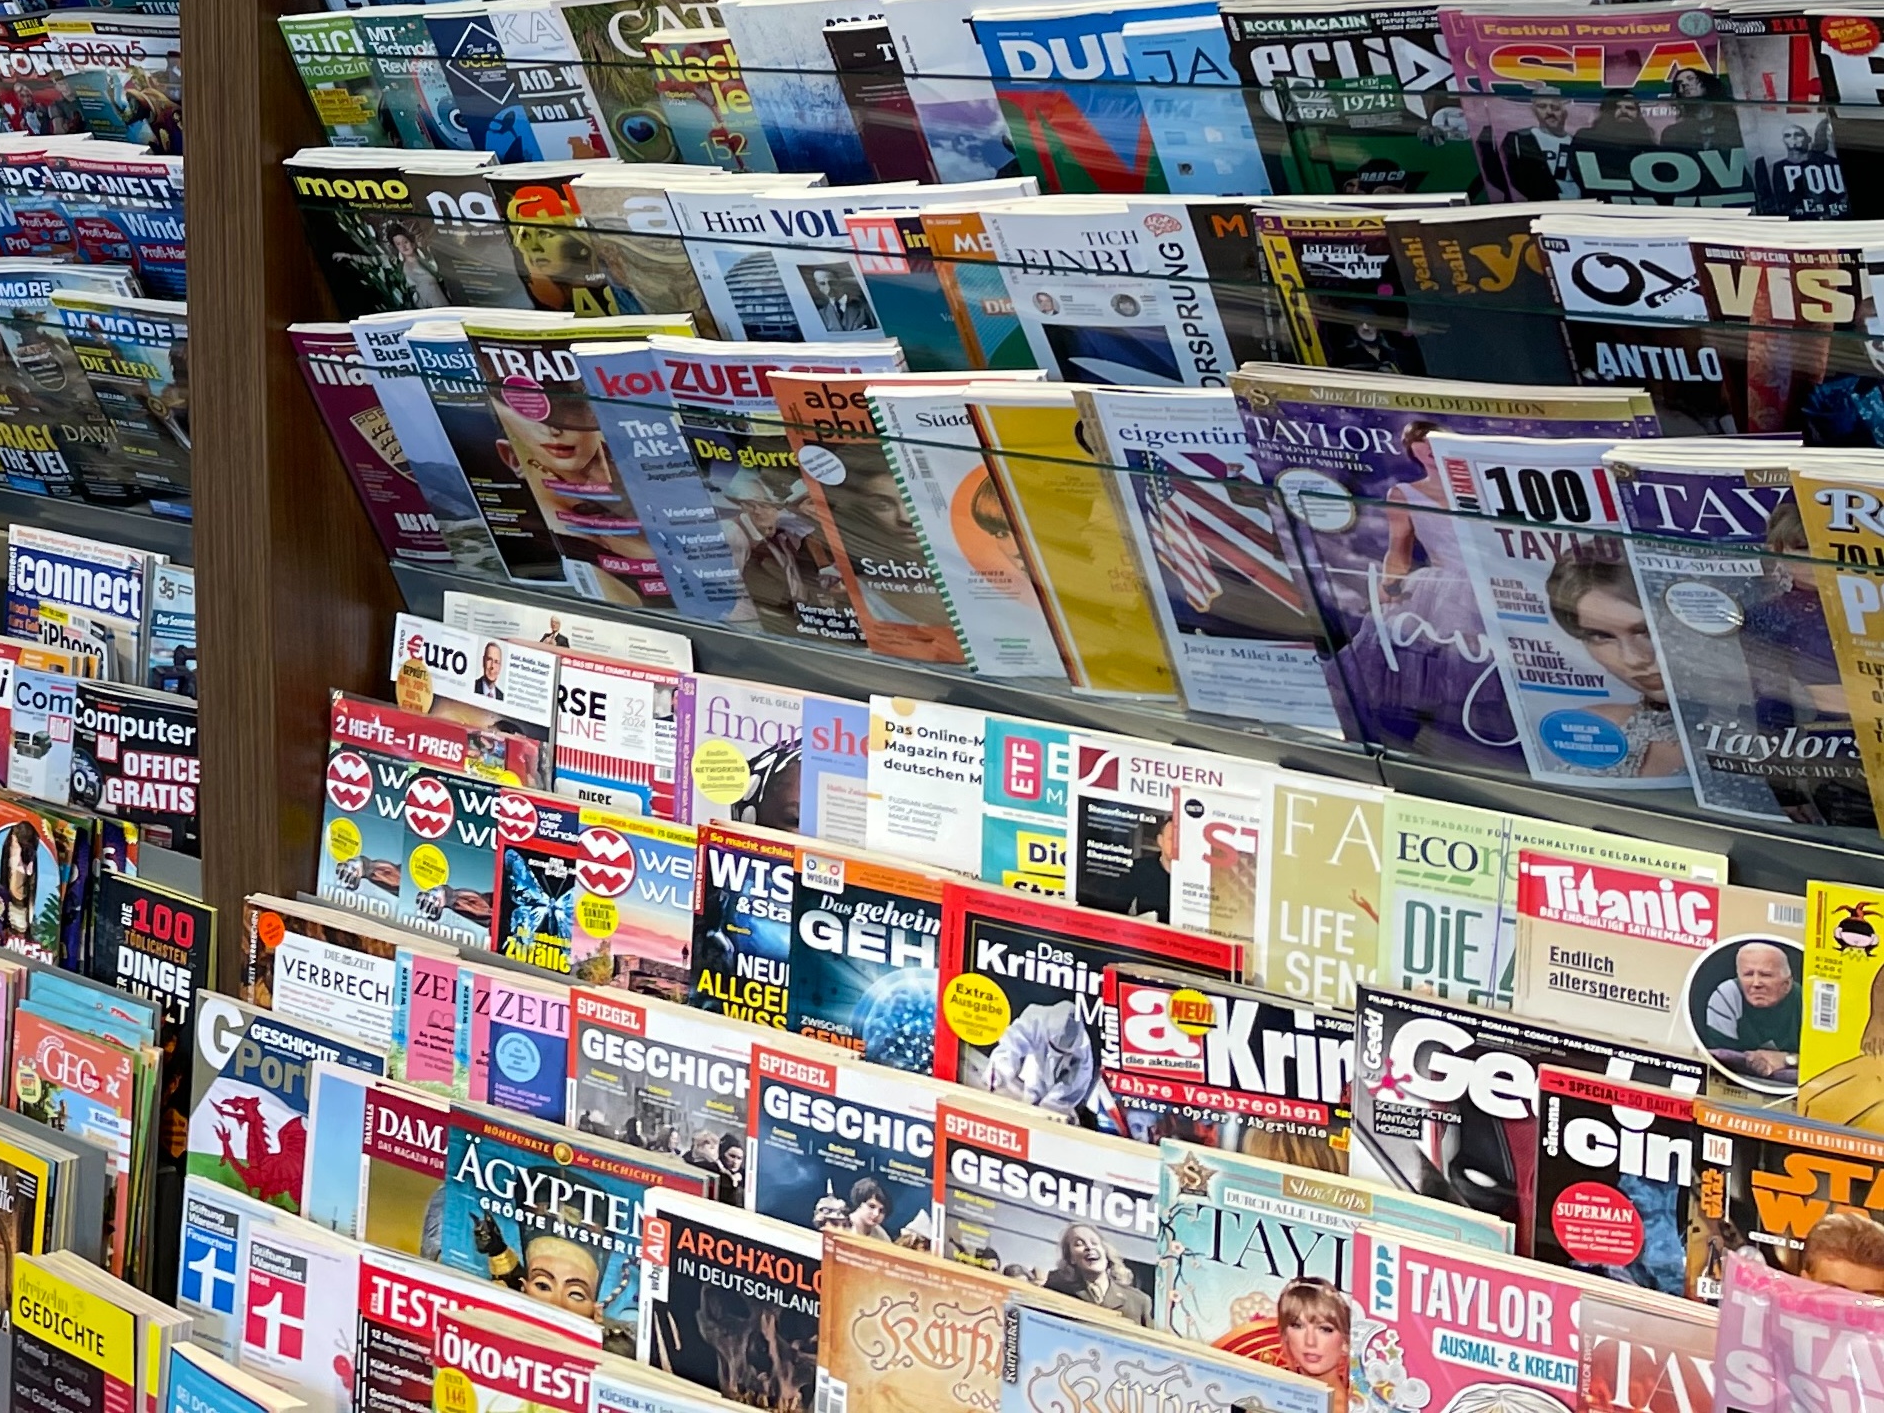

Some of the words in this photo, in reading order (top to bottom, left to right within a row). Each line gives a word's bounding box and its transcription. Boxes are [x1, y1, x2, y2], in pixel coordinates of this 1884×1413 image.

[1483, 22, 1562, 36] Festival
[1569, 19, 1671, 36] Preview
[299, 174, 409, 201] mono
[1395, 395, 1546, 417] GOLDEDITION
[695, 438, 731, 462] Die
[1245, 416, 1401, 457] TAYLOR
[1484, 467, 1592, 523] 100
[1636, 555, 1762, 575] STYLE-SPECIAL
[16, 552, 142, 619] connect
[1507, 637, 1561, 658] STYLE,
[1513, 653, 1573, 672] CLIQUE,
[0, 667, 9, 697] i
[1517, 668, 1605, 689] LOVESTORY
[335, 715, 345, 732] 2
[348, 718, 393, 745] HEFTE
[407, 733, 414, 750] 1
[418, 735, 463, 762] PREIS
[885, 720, 912, 735] Das
[884, 739, 948, 760] Magazin
[952, 748, 975, 764] für
[123, 751, 200, 784] OFFICE
[884, 756, 967, 783] deutschen
[1131, 756, 1223, 787] STEUERN
[106, 777, 196, 816] GRATIS
[1521, 861, 1714, 935] Titanic
[1280, 900, 1355, 954] LIFE
[1539, 906, 1560, 920] DAS
[1562, 910, 1624, 931] ENDGÜLTIGE
[1627, 921, 1715, 948] SATIREMAGAZIN
[125, 931, 188, 964] TÖDLICHSTEN
[1549, 946, 1614, 973] Endlich
[117, 947, 191, 998] DINGE
[949, 995, 1003, 1015] Ausgabe
[955, 983, 1000, 1002] Extra-
[1549, 969, 1671, 1012] altersgerecht:
[577, 999, 640, 1030] SPIEGEL
[1171, 999, 1214, 1023] NEU!
[759, 1057, 830, 1088] SPIEGEL
[1125, 1056, 1145, 1068] die
[1147, 1057, 1201, 1071] aktuelle
[1376, 1100, 1461, 1124] SCIENCE-FICTION
[1376, 1113, 1420, 1129] FANTASY
[945, 1118, 1021, 1153] SPIEGEL
[1376, 1123, 1419, 1139] HORROR
[483, 1122, 551, 1153] HÖHEPUNKTE
[592, 1157, 664, 1186] GESCHICHTE
[1556, 1201, 1633, 1224] SUPERMAN
[186, 1227, 233, 1253] Finanztest
[251, 1241, 292, 1269] Stiftung
[251, 1255, 303, 1282] Warentest
[1375, 1245, 1393, 1311] TOPP
[1407, 1260, 1553, 1346] TAYLOR
[19, 1297, 106, 1358] GEDICHTE
[442, 1325, 502, 1378] ÖKO
[519, 1355, 590, 1406] TEST
[1439, 1334, 1504, 1369] AUSMAL-
[1509, 1351, 1521, 1373] &
